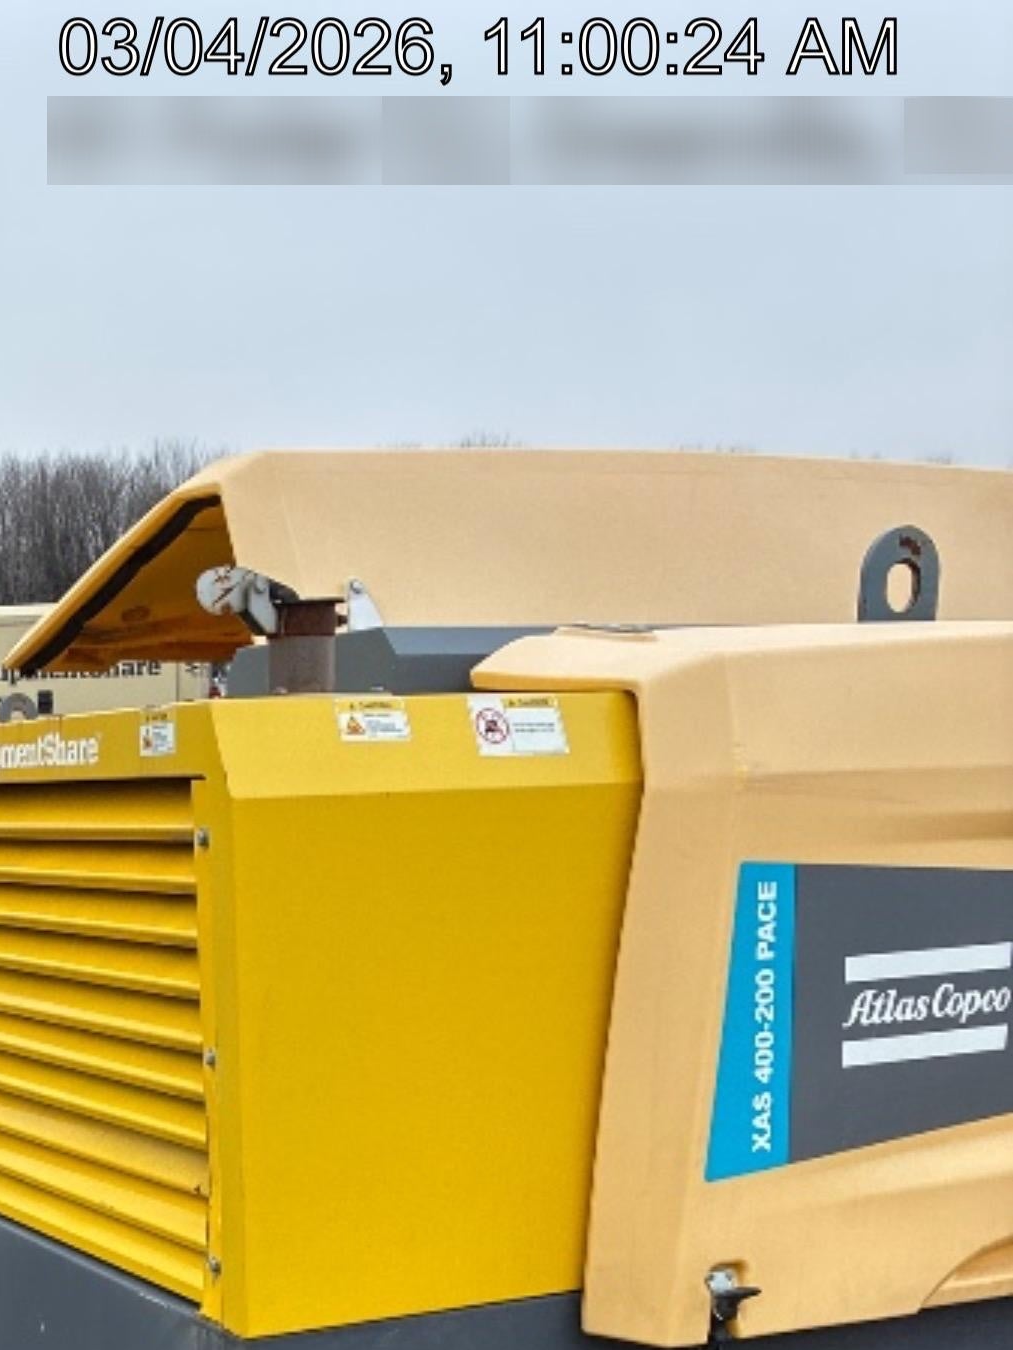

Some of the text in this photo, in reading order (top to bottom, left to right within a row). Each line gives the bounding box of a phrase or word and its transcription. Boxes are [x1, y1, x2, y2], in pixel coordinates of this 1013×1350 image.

[752, 881, 777, 1152] XAS 400-200 PACE
